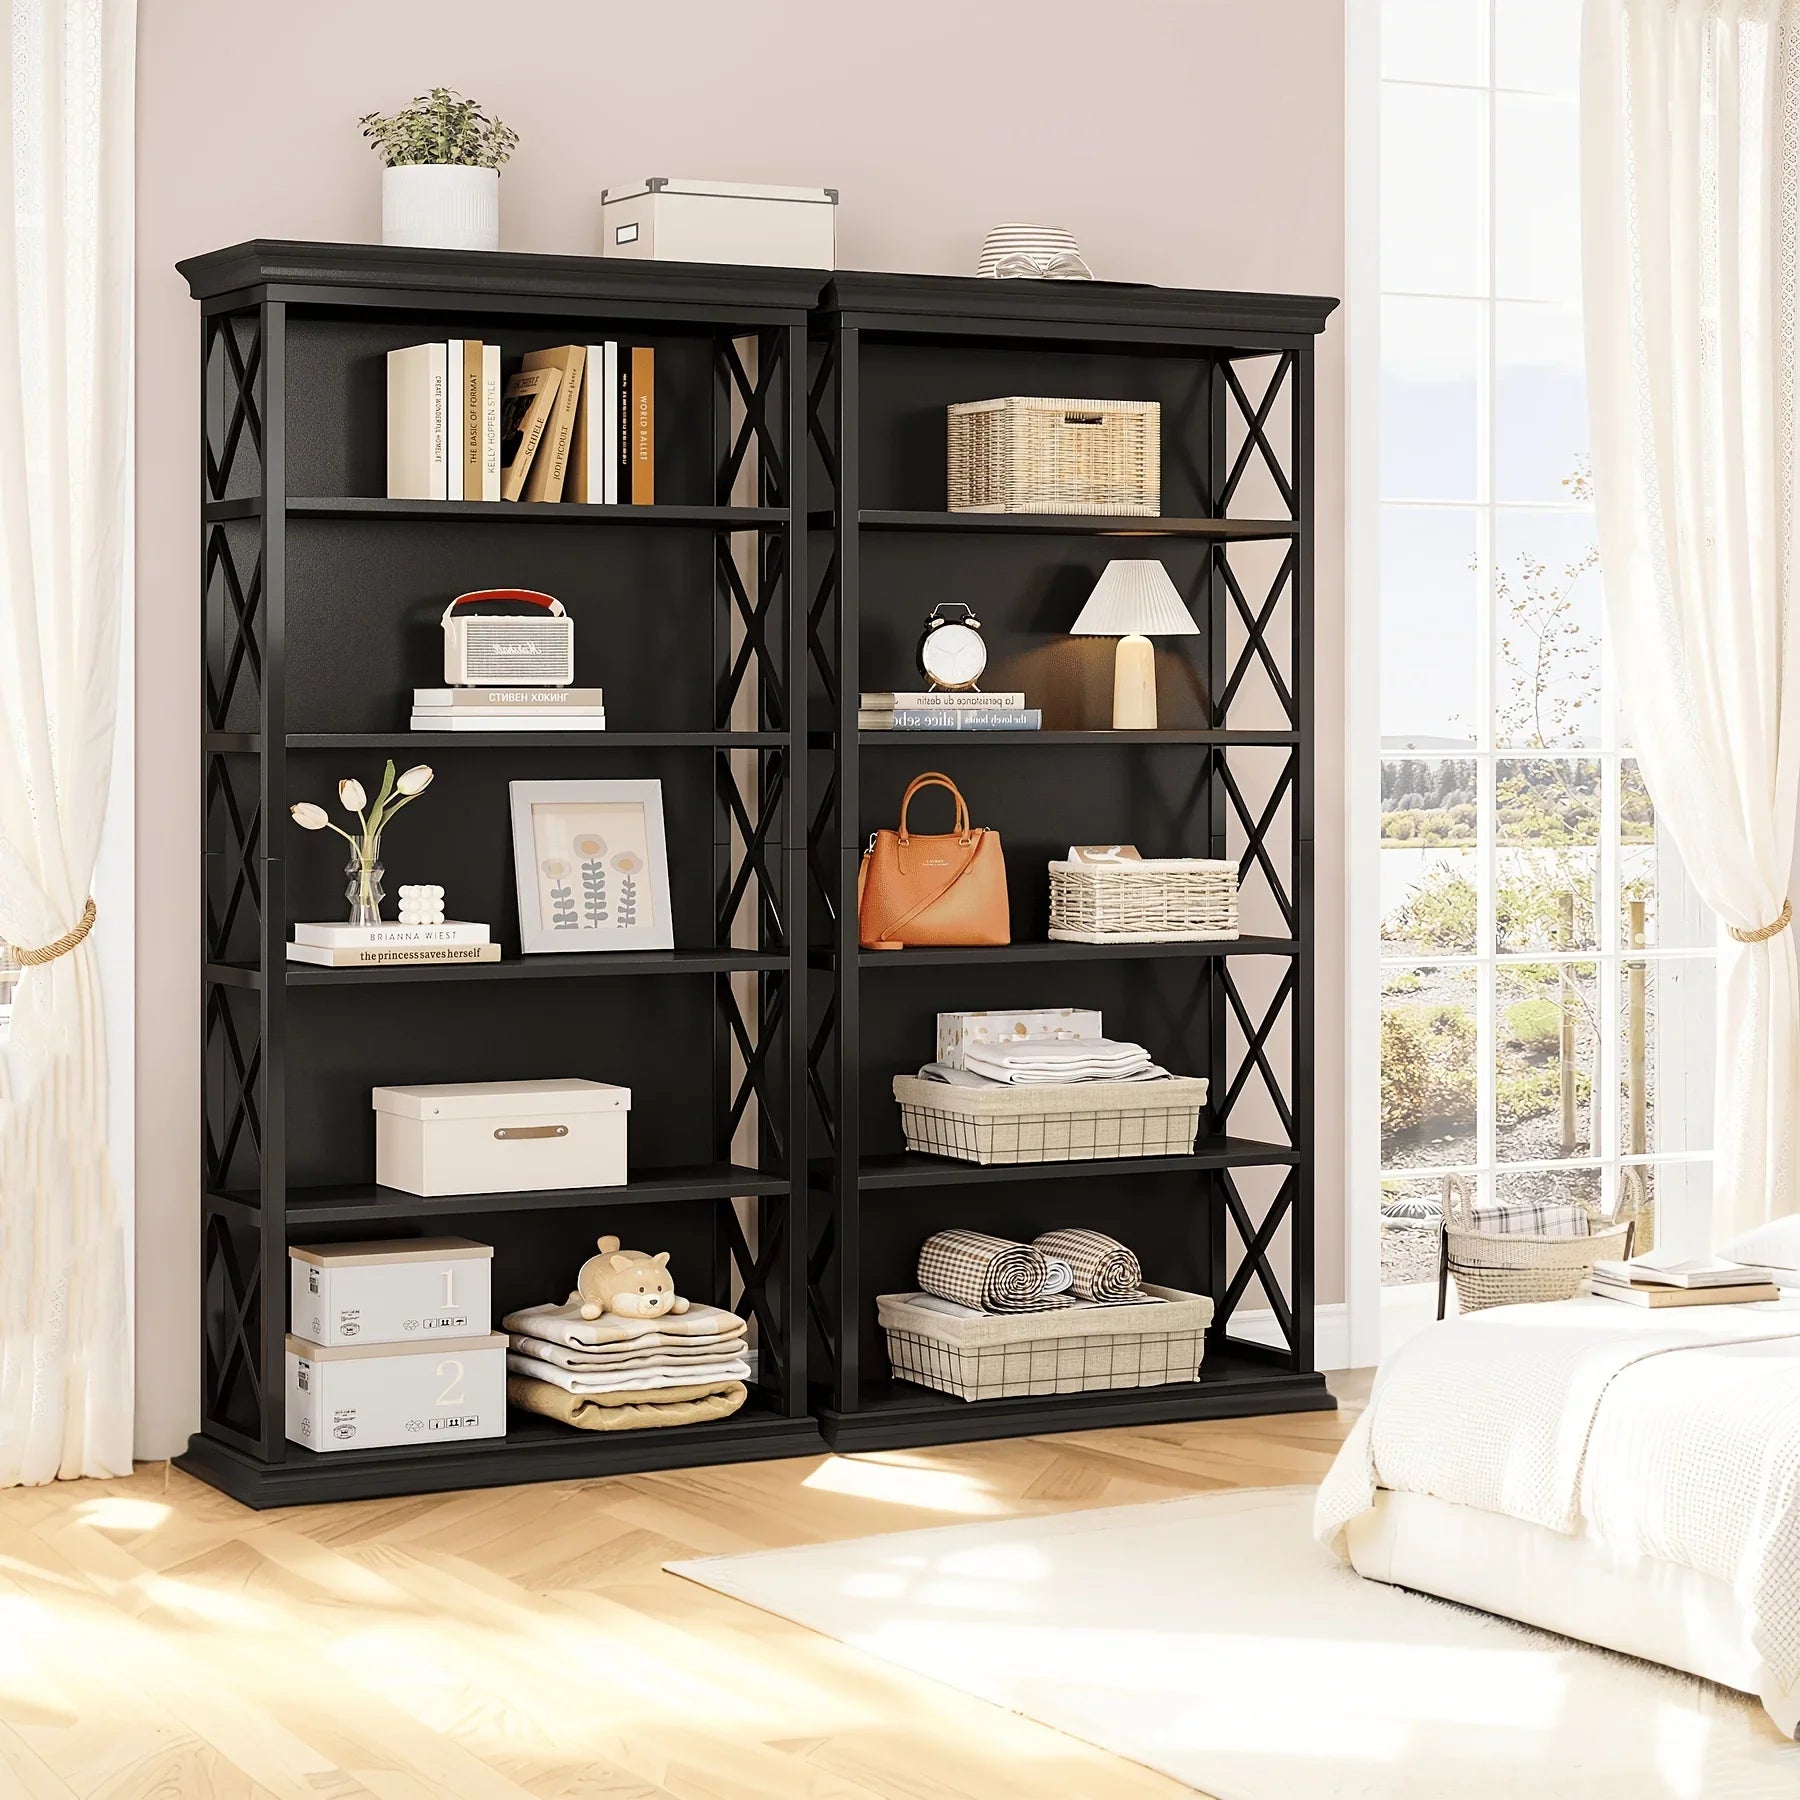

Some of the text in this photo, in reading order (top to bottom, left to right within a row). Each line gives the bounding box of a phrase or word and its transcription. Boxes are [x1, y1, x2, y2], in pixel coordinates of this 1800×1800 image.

[470, 410, 477, 421] OF
[487, 380, 496, 474] KELLY HOPPEN STYLE
[640, 395, 648, 460] WORLD BALLET
[525, 418, 544, 457] SCHIELE
[553, 426, 568, 480] JODI PICOULT
[489, 692, 569, 702] СТИВЕН ХОКИНГ
[360, 947, 481, 963] the princess saves herself
[370, 931, 457, 942] BRIANNA WIEST
[440, 1268, 460, 1308] 1
[435, 1360, 464, 1406] 2
